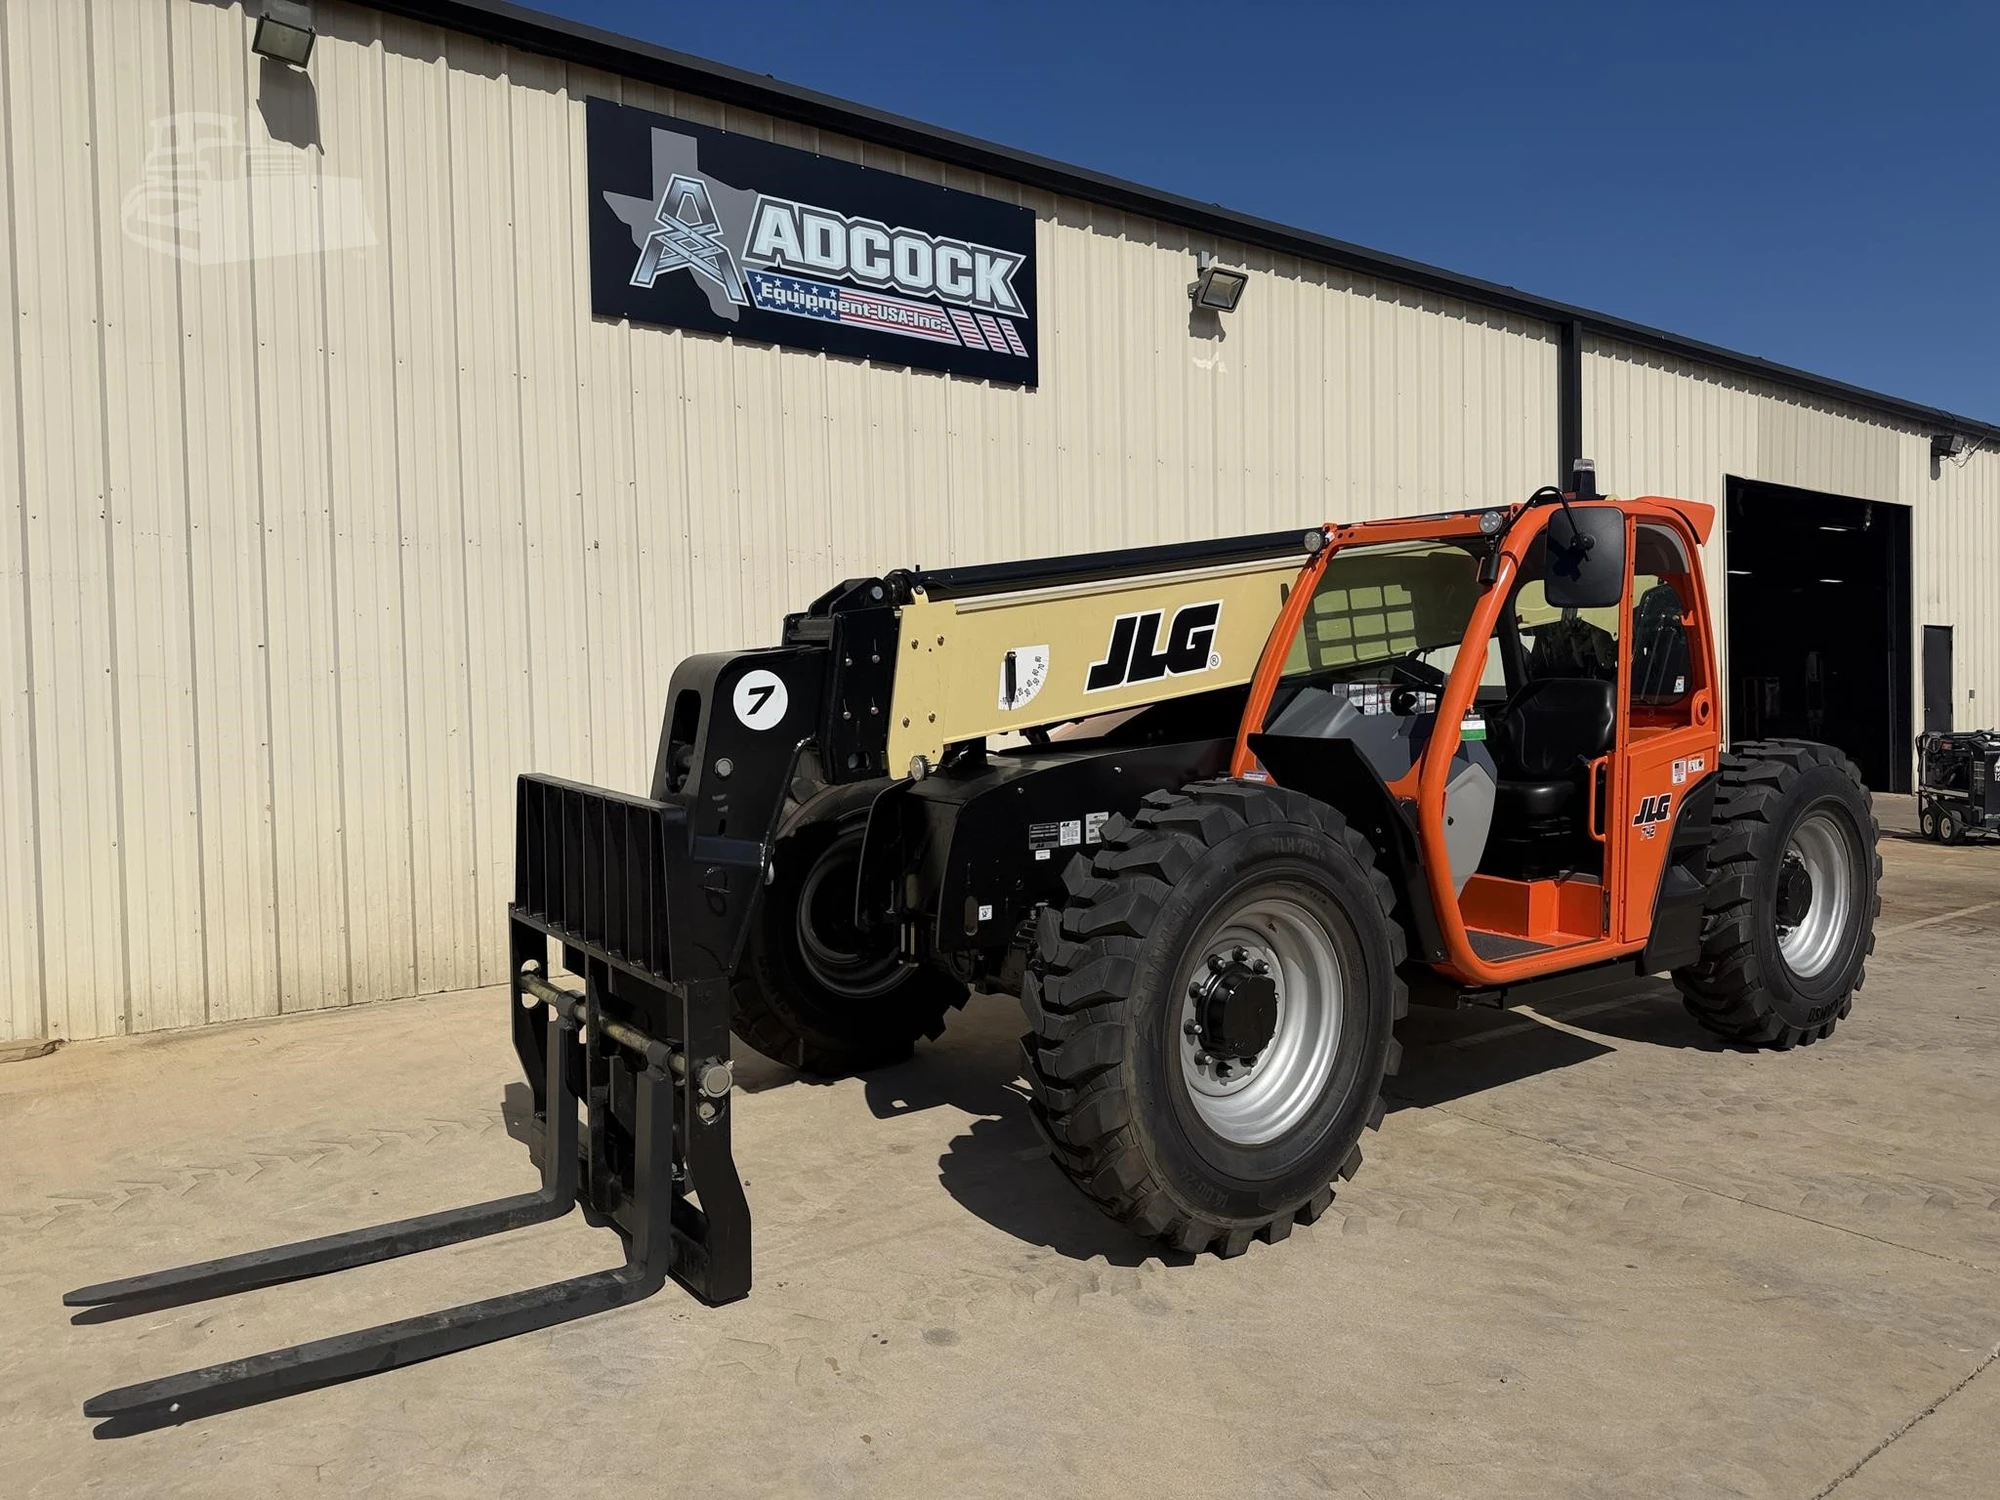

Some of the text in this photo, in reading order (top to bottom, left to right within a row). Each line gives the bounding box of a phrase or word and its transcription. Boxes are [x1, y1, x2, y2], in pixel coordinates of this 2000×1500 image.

[743, 196, 1027, 317] ADCOCK
[761, 281, 870, 317] Equipment
[877, 305, 909, 325] USA
[1085, 601, 1222, 692] JLG
[746, 685, 776, 716] 7
[1633, 793, 1672, 826] JLG
